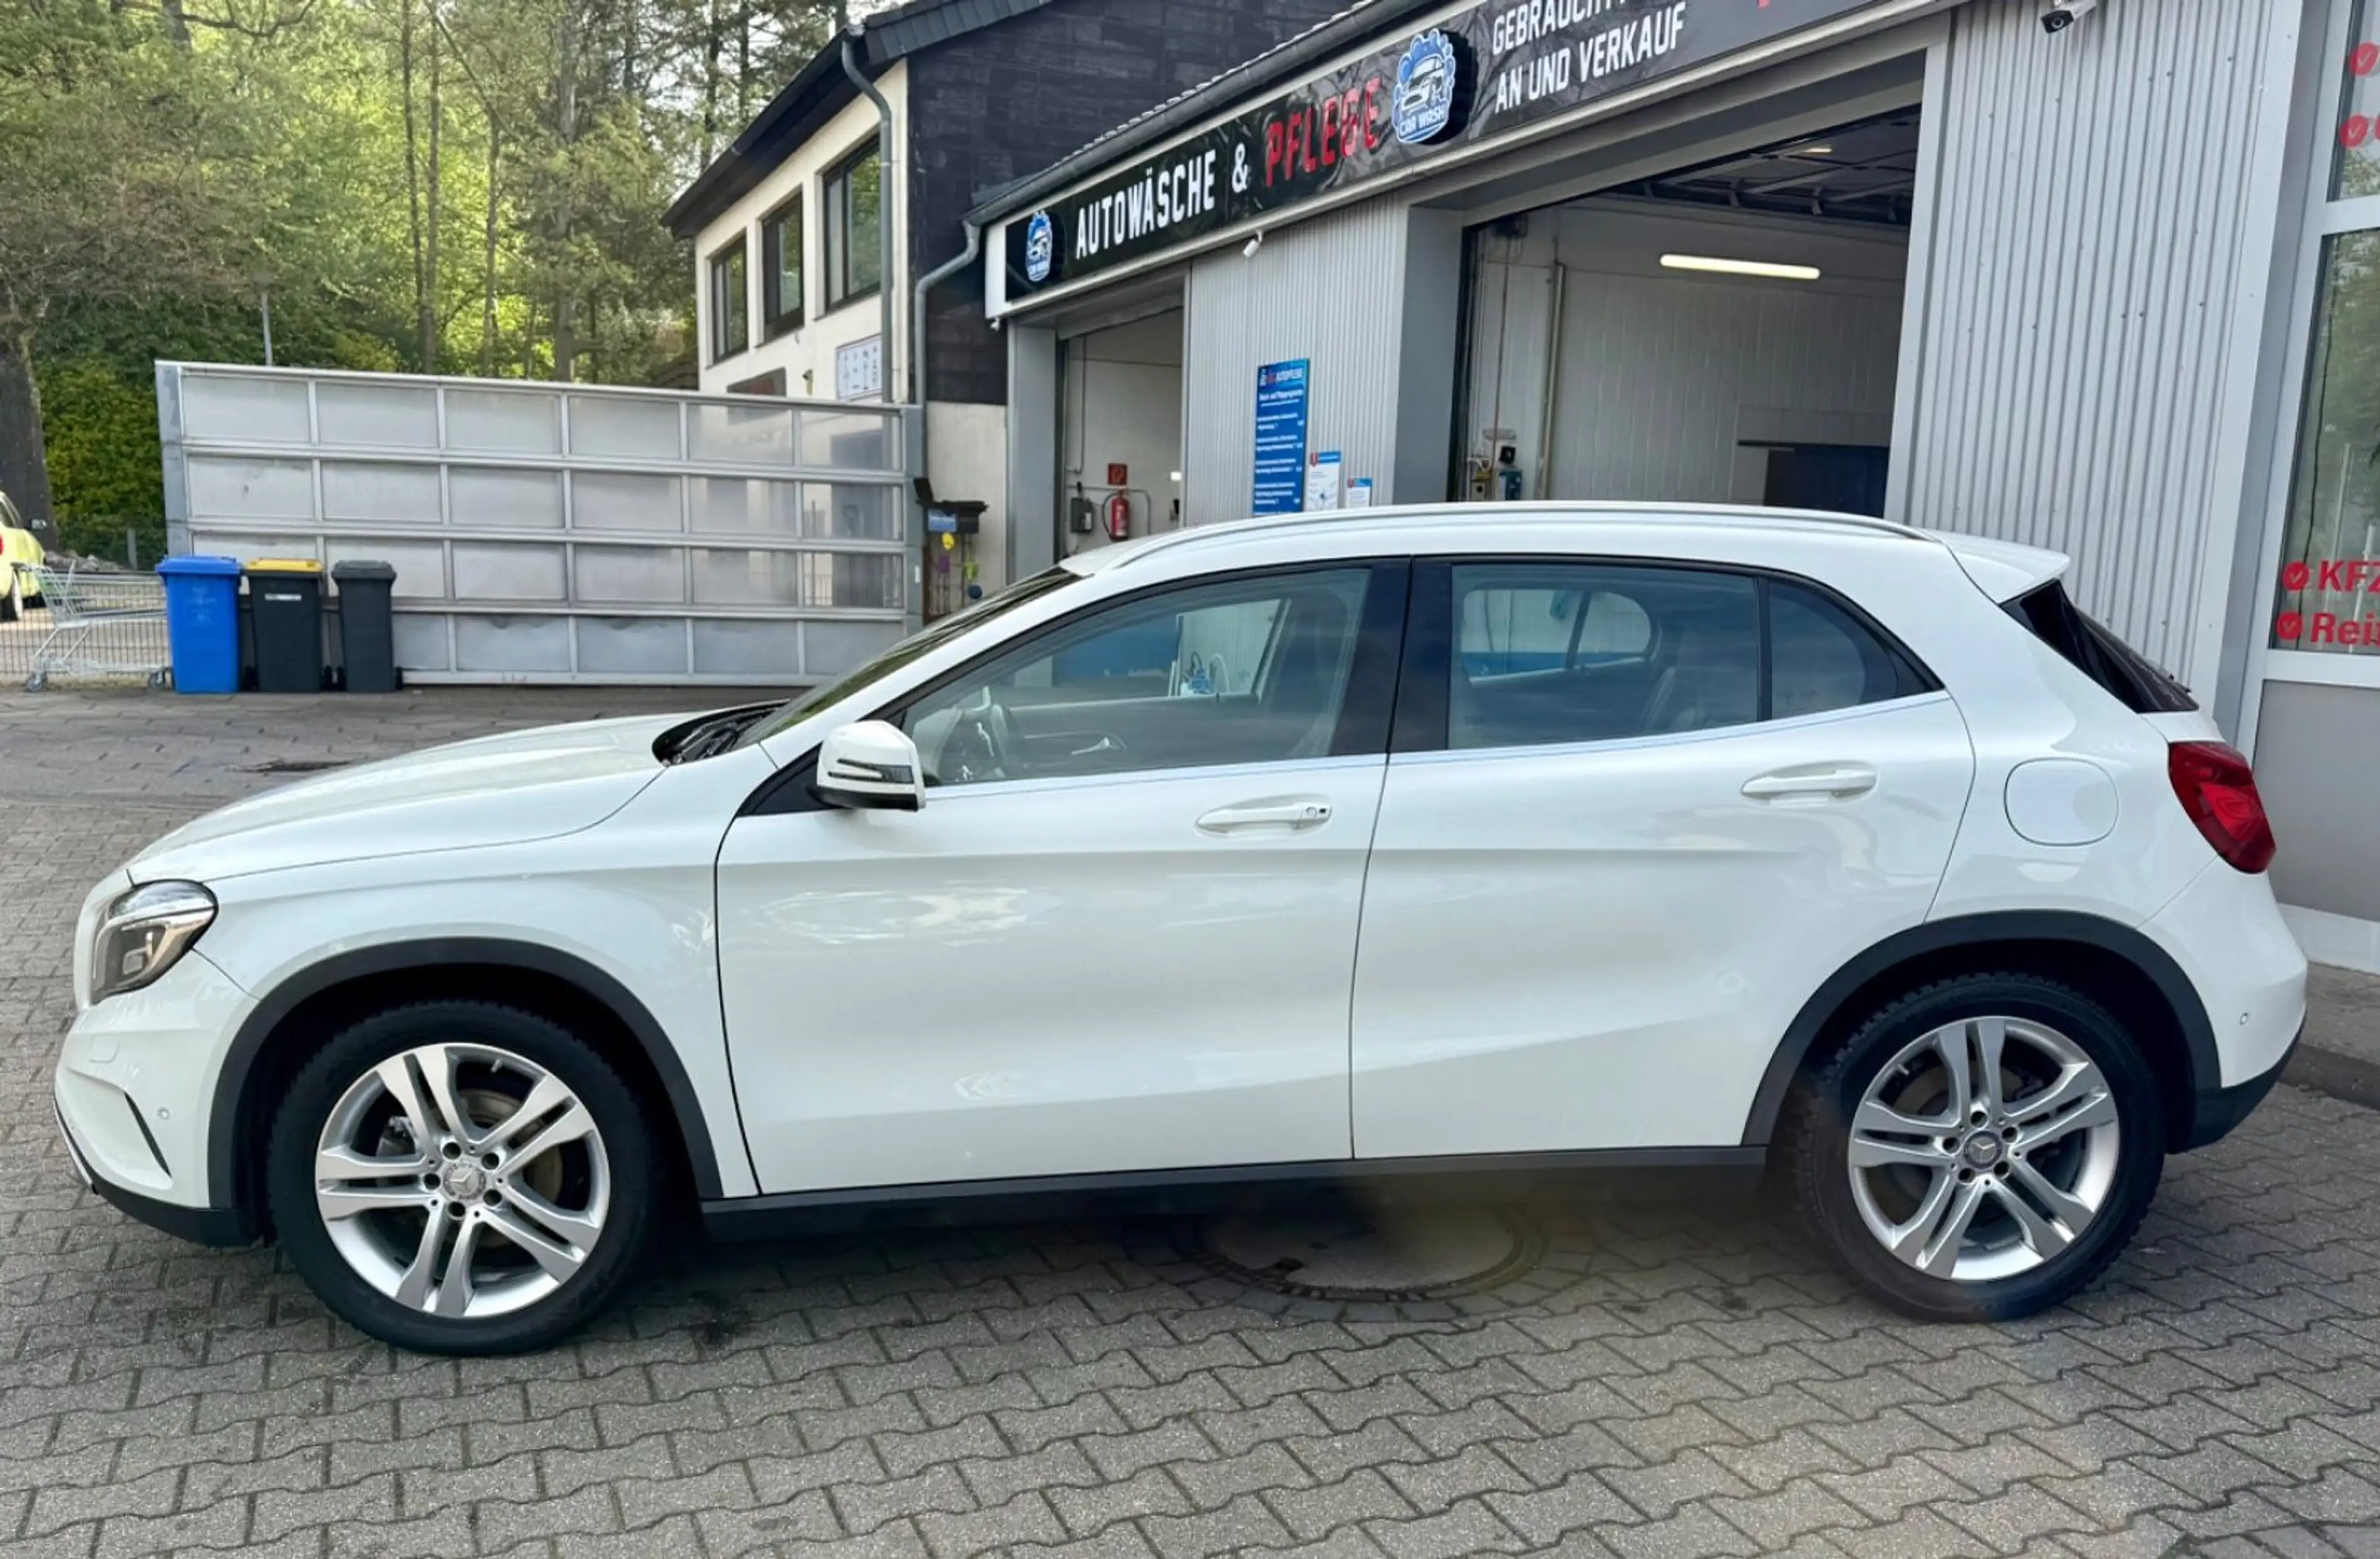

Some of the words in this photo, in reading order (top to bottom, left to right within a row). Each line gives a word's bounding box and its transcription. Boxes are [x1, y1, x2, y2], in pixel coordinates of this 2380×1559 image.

[1494, 66, 1523, 113] AN
[1528, 48, 1571, 101] UND
[1580, 1, 1686, 83] VERKAUF
[1075, 149, 1217, 260] AUTOWÄSCHE
[1232, 142, 1249, 193] &
[1266, 77, 1381, 187] PFLEGE
[2310, 611, 2380, 647] Rei
